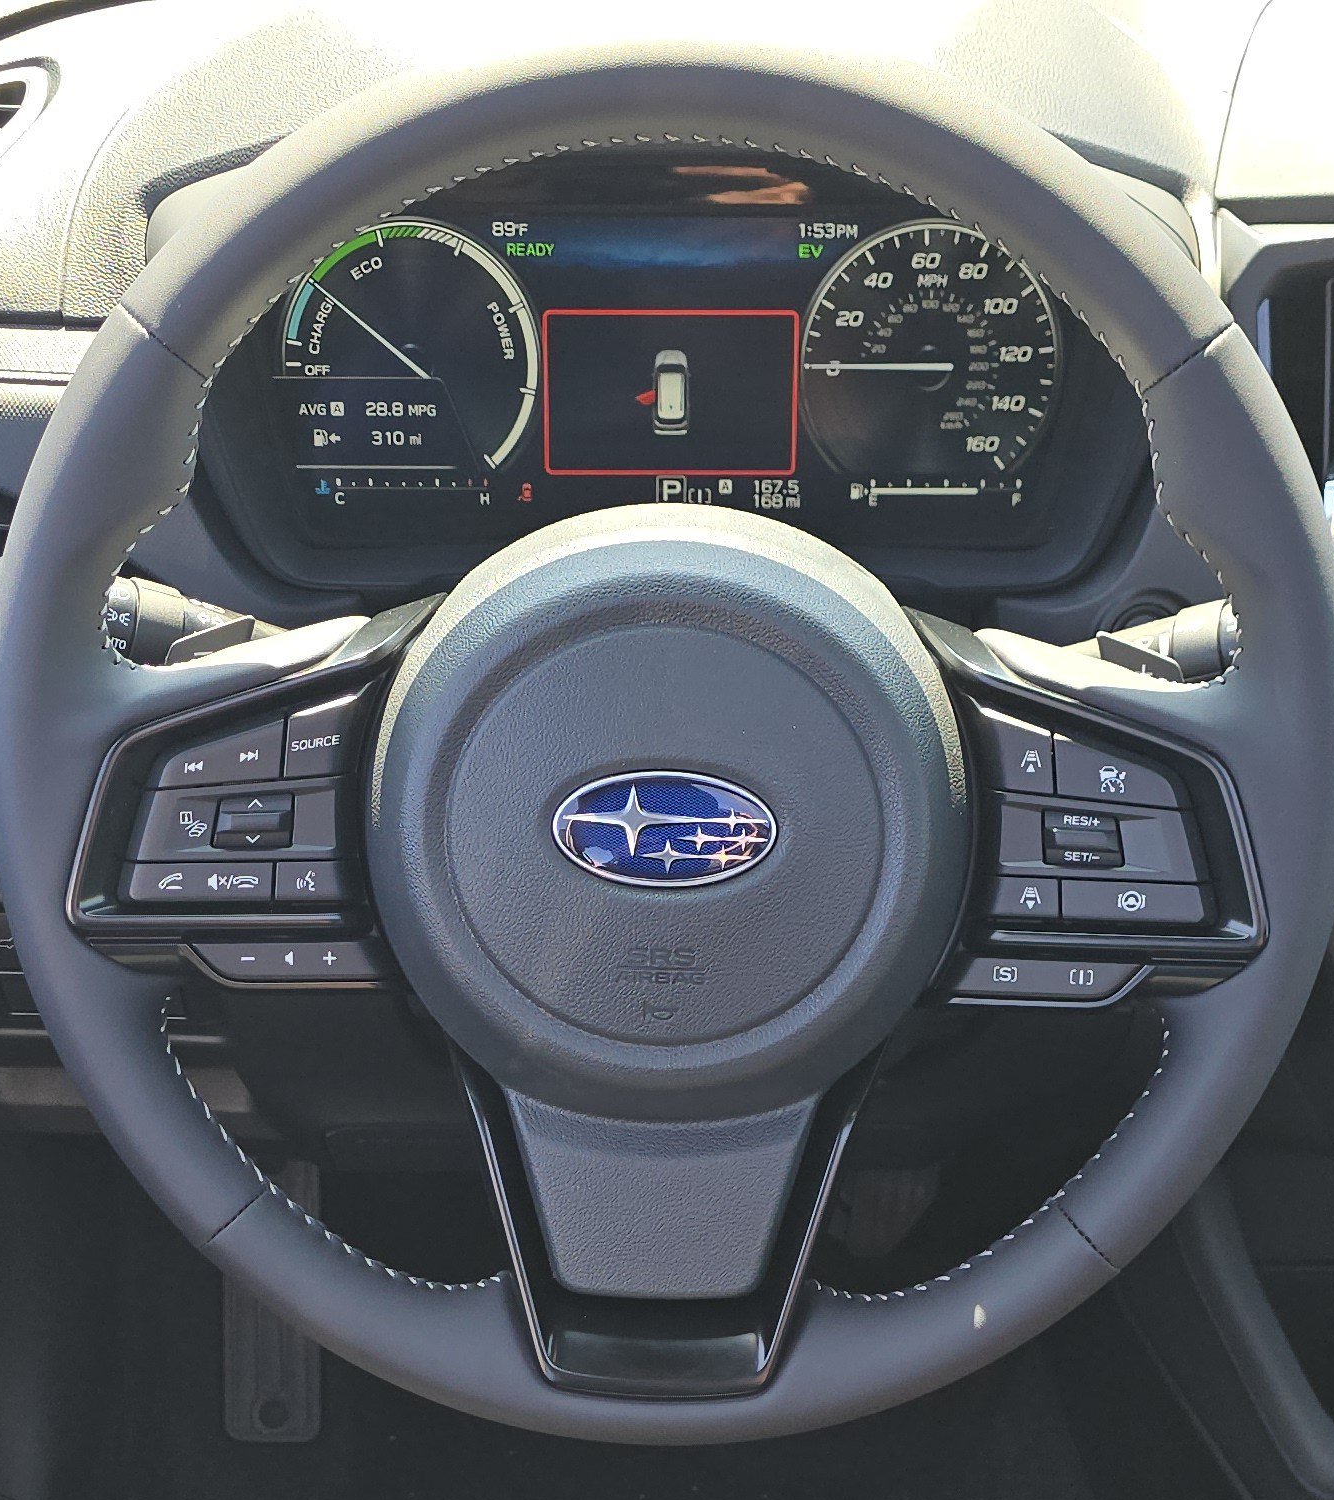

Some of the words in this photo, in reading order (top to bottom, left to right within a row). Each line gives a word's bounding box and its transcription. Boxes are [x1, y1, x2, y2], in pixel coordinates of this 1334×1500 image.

[506, 242, 555, 257] READY
[798, 243, 824, 259] EV
[349, 256, 384, 281] ECO
[910, 252, 942, 270] 60
[958, 262, 989, 280] 80
[863, 272, 894, 289] 40
[916, 273, 949, 289] MPH
[983, 297, 1019, 315] 100
[835, 310, 865, 328] 20
[486, 301, 516, 360] POWER
[998, 345, 1034, 363] 120
[304, 364, 331, 376] OFF
[298, 403, 327, 417] AVG
[365, 401, 404, 417] 28.8
[408, 404, 437, 417] MPG
[991, 394, 1027, 412] 140
[371, 430, 405, 446] 310
[409, 433, 423, 446] mi
[965, 435, 1001, 453] 160
[662, 479, 682, 502] P
[753, 479, 800, 495] 167.5
[334, 491, 346, 505] C
[479, 492, 491, 506] H
[753, 493, 784, 509] 168
[290, 734, 341, 752] SOURCE
[1063, 814, 1101, 828] RES/+
[628, 946, 697, 968] SRS
